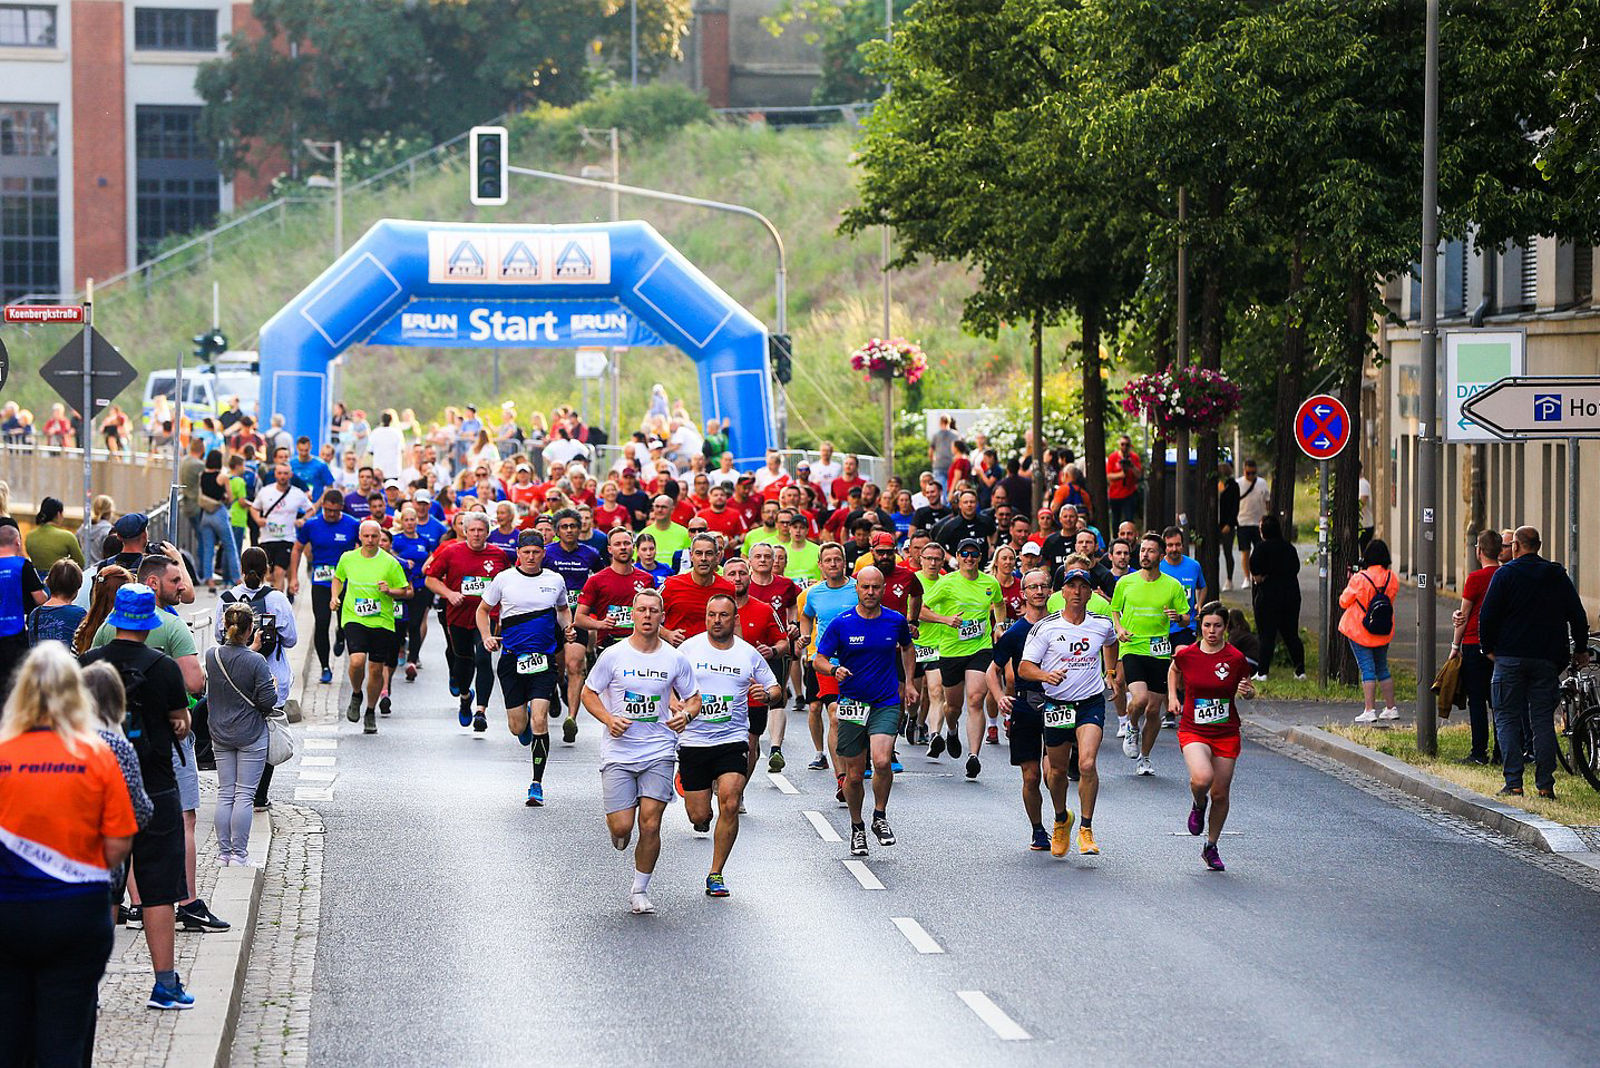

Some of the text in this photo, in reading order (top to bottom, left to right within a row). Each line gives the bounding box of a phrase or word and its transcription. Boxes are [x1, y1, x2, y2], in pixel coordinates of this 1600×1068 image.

[9, 308, 78, 321] Koenbergkstraße
[469, 308, 559, 342] Start
[1570, 398, 1600, 417] Ho
[464, 582, 485, 592] 4459
[356, 604, 378, 614] 4124
[961, 624, 982, 637] 4281
[517, 656, 544, 671] 3740
[625, 701, 656, 714] 4019
[701, 702, 729, 716] 4024
[839, 704, 866, 717] 5617
[1198, 703, 1225, 720] 4478
[1045, 709, 1072, 723] 5076
